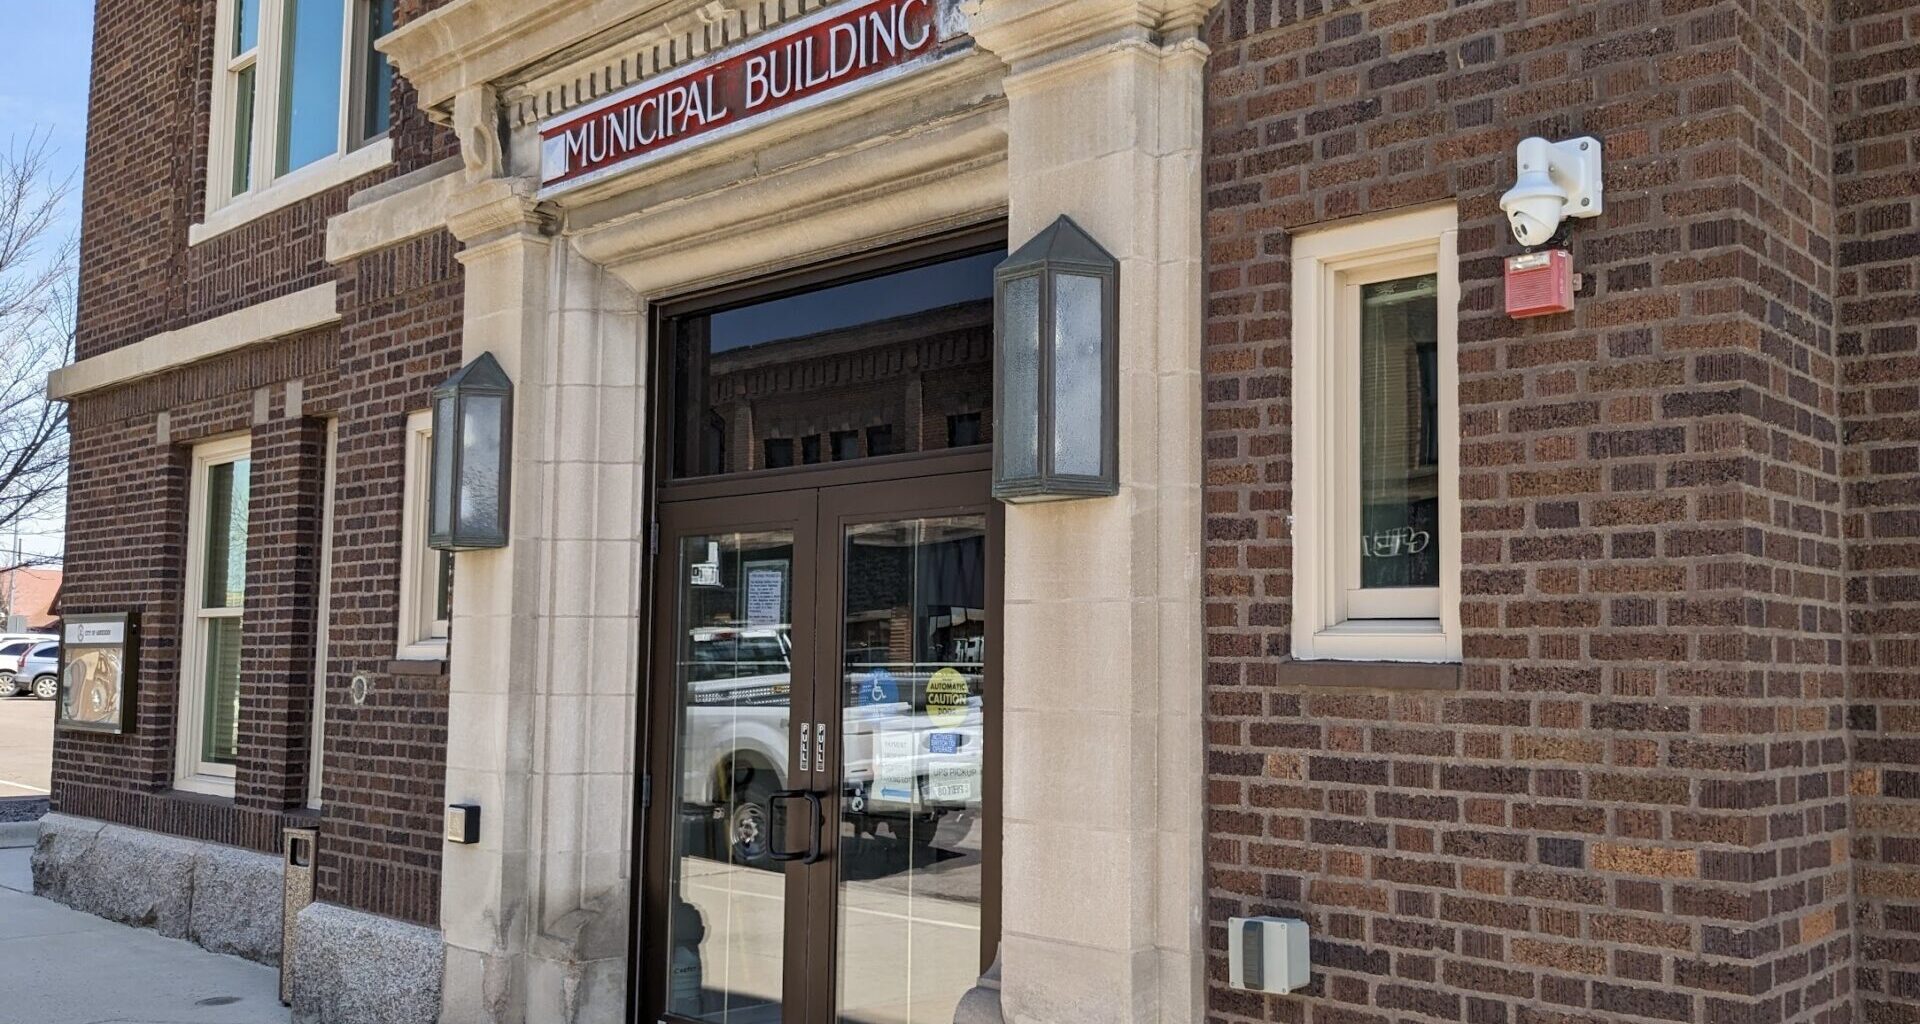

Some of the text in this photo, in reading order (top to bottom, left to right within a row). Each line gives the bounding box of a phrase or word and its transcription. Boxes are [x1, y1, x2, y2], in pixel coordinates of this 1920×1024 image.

[564, 0, 930, 173] MUNICIPAL BUILDING
[930, 682, 966, 691] AUTOMATIC
[928, 693, 967, 705] CAUTION
[933, 767, 977, 777] UPS PICKUP
